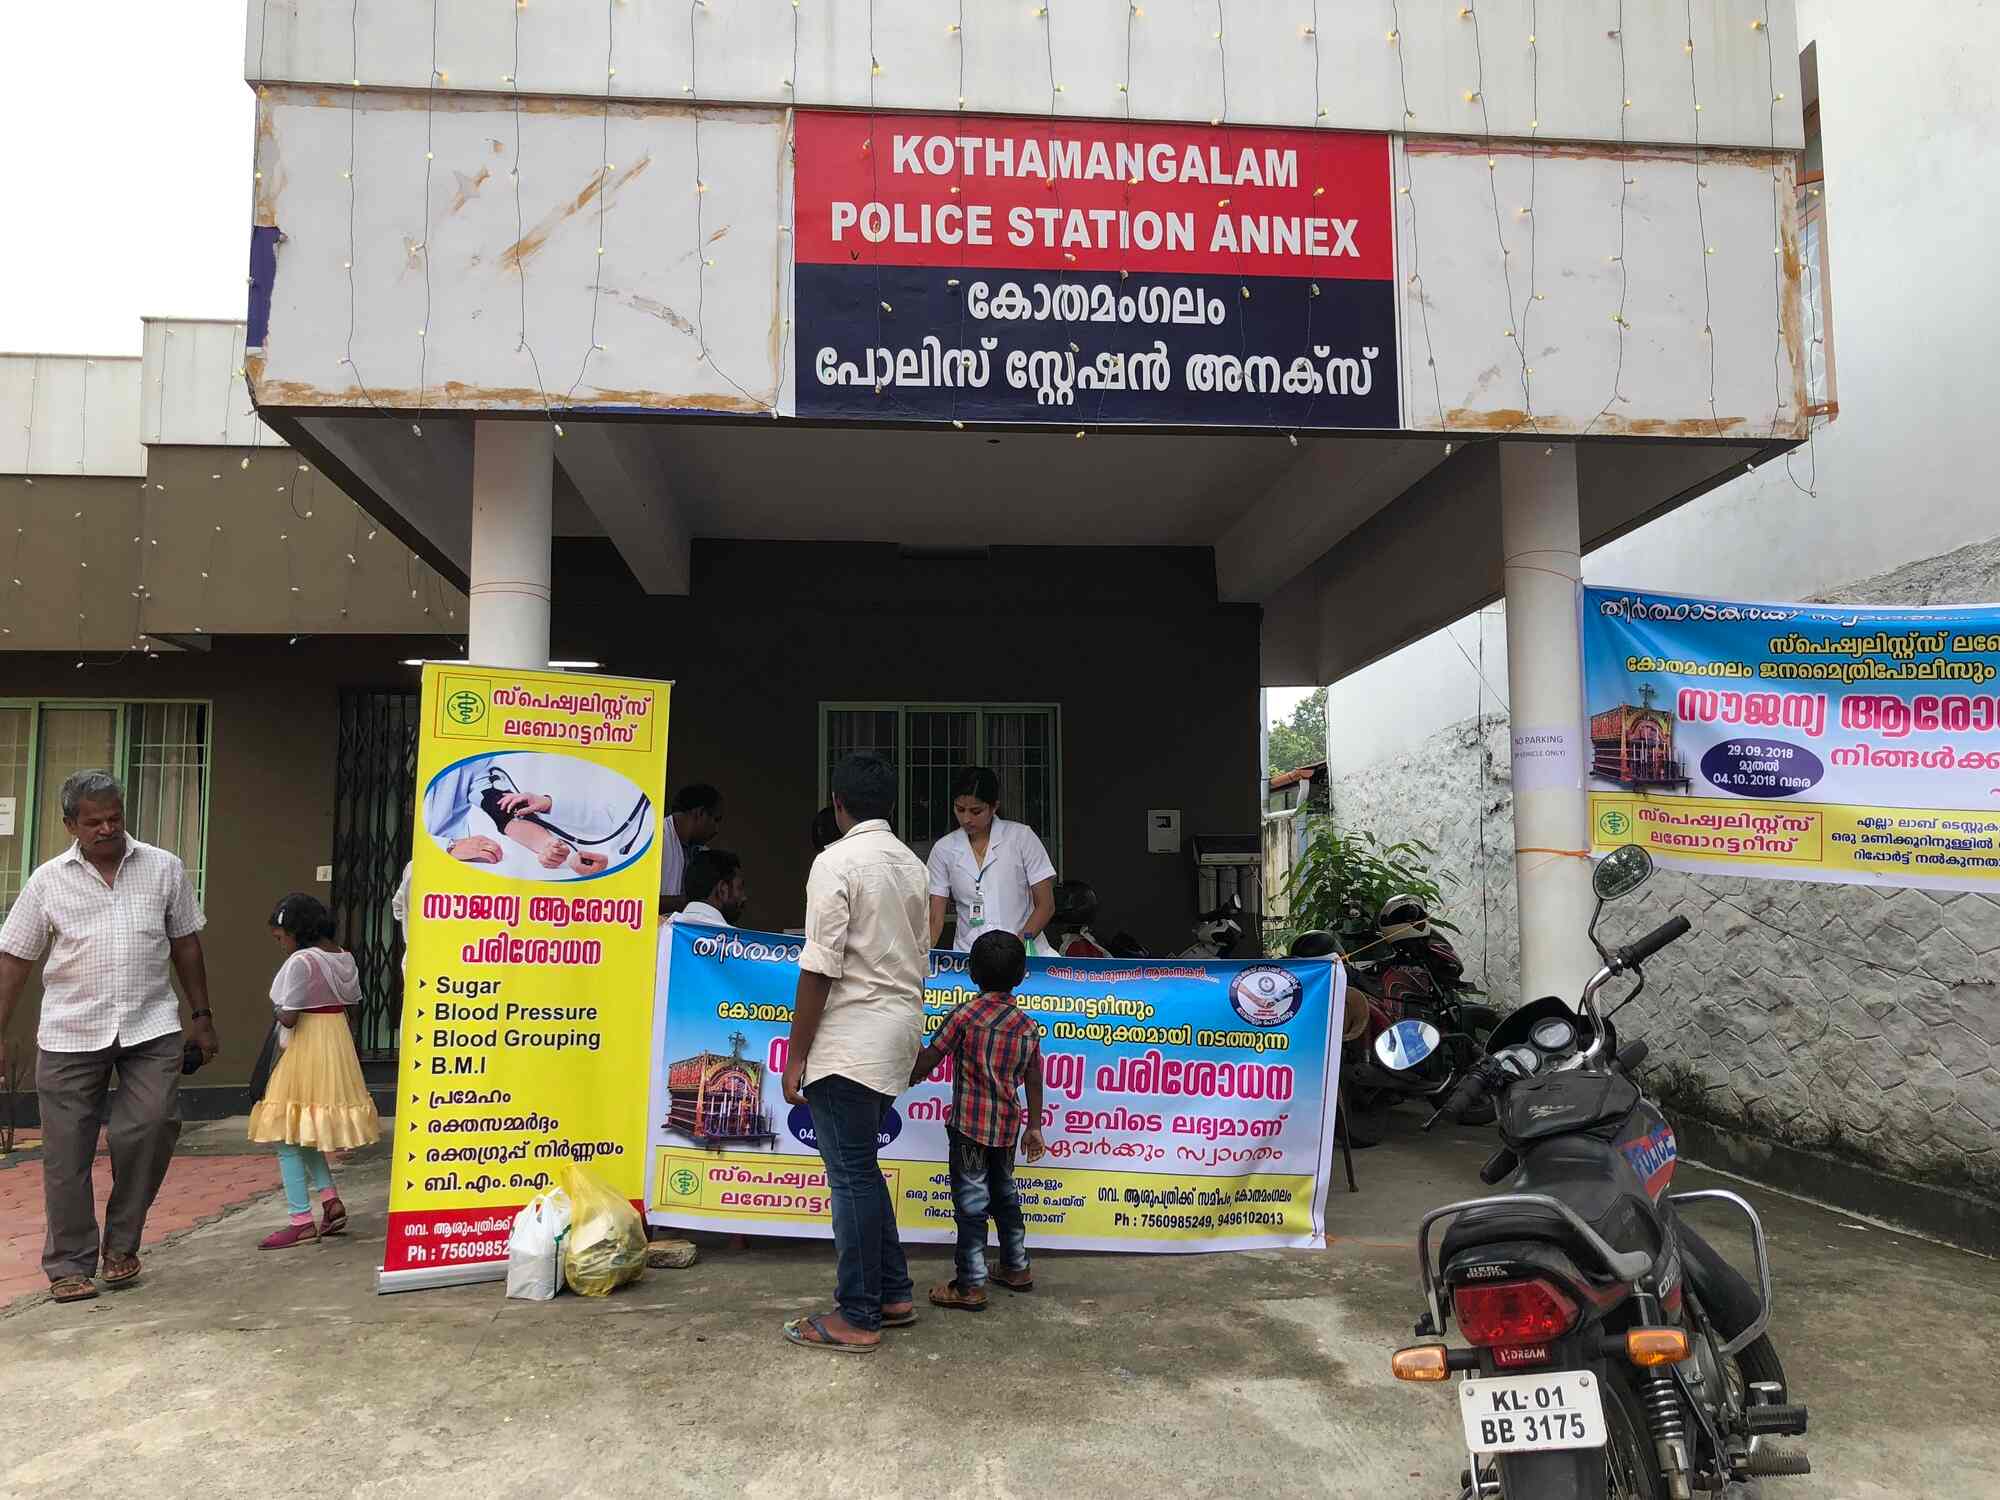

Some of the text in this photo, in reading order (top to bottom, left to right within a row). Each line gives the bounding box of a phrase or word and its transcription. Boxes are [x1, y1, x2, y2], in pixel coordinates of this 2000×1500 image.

[893, 135, 1298, 188] KOTHAMANGALAM
[831, 201, 1360, 258] POLICE STATION ANNEX
[967, 281, 1226, 325] കോതമംഗലം
[1626, 656, 1752, 679] കോതമംഗലം
[1525, 735, 1564, 744] PARKING
[1727, 745, 1794, 759] 29.09.2018
[1739, 760, 1779, 773] മുതൽ
[1713, 773, 1812, 788] 04.10.2018 വരെ
[1831, 833, 1856, 844] ഒരു
[529, 896, 643, 929] ആരോഗ്യ
[462, 931, 601, 965] പരിശോധന
[436, 976, 501, 998] Sugar
[435, 1003, 598, 1020] Blood Pressure
[433, 1029, 601, 1050] Blood Grouping
[1054, 1021, 1192, 1046] സംയുക്തമായി
[1197, 1031, 1289, 1053] നടത്തുന്ന
[431, 1056, 486, 1074] B.M.I
[1096, 1050, 1293, 1101] പരിശോധന
[429, 1090, 511, 1109] പ്രമേഹം
[1064, 1107, 1162, 1134] ഇവിടെ
[1172, 1114, 1289, 1141] ലഭ്യമാണ്
[1114, 1212, 1130, 1226] Ph
[1218, 1211, 1285, 1226] 9496102013
[407, 1245, 426, 1261] Ph
[441, 1240, 510, 1259] 75609852
[1534, 1385, 1565, 1408] 01
[1481, 1413, 1585, 1444] BB 3175
